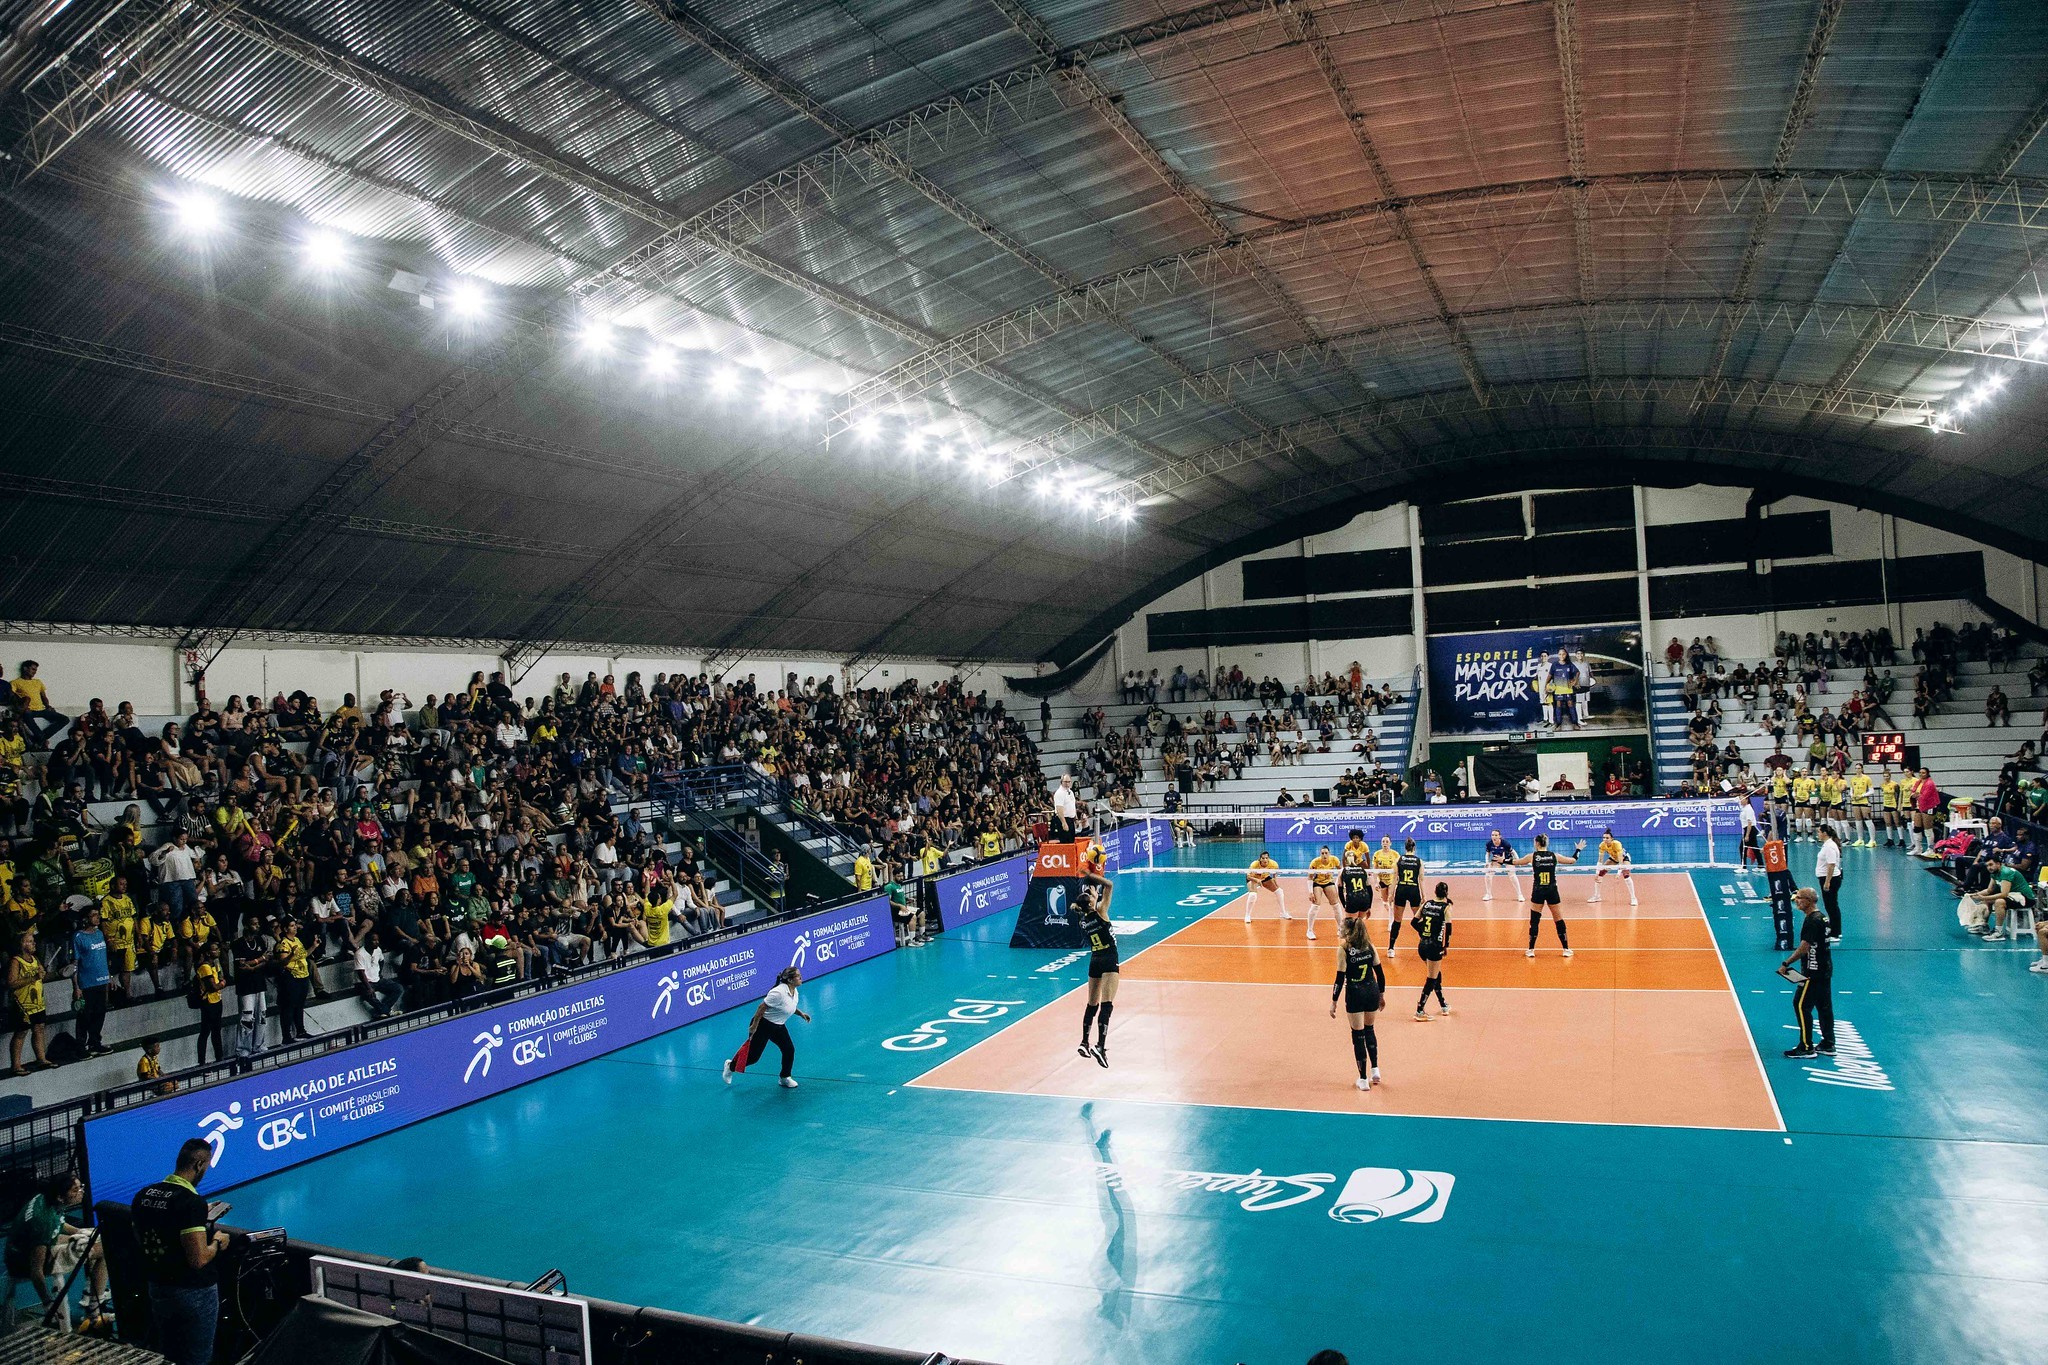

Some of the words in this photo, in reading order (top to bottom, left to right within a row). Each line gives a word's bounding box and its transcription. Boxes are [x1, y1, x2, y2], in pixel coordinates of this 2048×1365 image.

[1456, 650, 1518, 662] ESPORTE
[1526, 646, 1532, 659] É
[1455, 660, 1497, 682] MAIS
[1499, 658, 1540, 680] QUE
[1454, 680, 1529, 702] PLACAR
[1868, 736, 1874, 744] 2
[1895, 736, 1902, 744] 0
[1314, 824, 1334, 835] CBC
[1428, 822, 1448, 832] CBC
[1548, 820, 1569, 830] CBC
[1673, 817, 1696, 828] CBC
[1042, 855, 1070, 868] GOL
[1351, 878, 1363, 890] 14
[1403, 869, 1414, 882] 12
[1539, 872, 1550, 884] 10
[976, 892, 989, 909] CBC
[1176, 885, 1245, 906] enel
[813, 922, 841, 938] FORMAÇÃO
[842, 921, 848, 929] DE
[848, 914, 868, 927] ATLETAS
[1425, 916, 1432, 932] 3
[816, 941, 835, 962] CBC
[683, 960, 719, 979] FORMAÇÃO
[720, 958, 728, 967] DE
[729, 949, 755, 964] ATLETAS
[1359, 964, 1368, 980] 7
[716, 974, 734, 988] COMITÊ
[731, 979, 750, 991] CLUBES
[686, 981, 711, 1006] CBC
[508, 1009, 557, 1034] FORMAÇÃO
[559, 1006, 570, 1018] DE
[571, 995, 605, 1015] ATLETAS
[553, 1024, 577, 1042] COMITÊ
[578, 1017, 607, 1033] BRASILEIRO
[881, 998, 1026, 1051] enel
[573, 1030, 598, 1045] CLUBES
[513, 1036, 546, 1066] CBC
[252, 1079, 327, 1112] FORMAÇÃO
[329, 1073, 346, 1089] DE
[348, 1057, 397, 1084] ATLETAS
[319, 1097, 356, 1118] COMITÊ
[357, 1085, 400, 1106] BRASILEIRO
[350, 1101, 385, 1120] CLUBES
[257, 1112, 307, 1150] CBC
